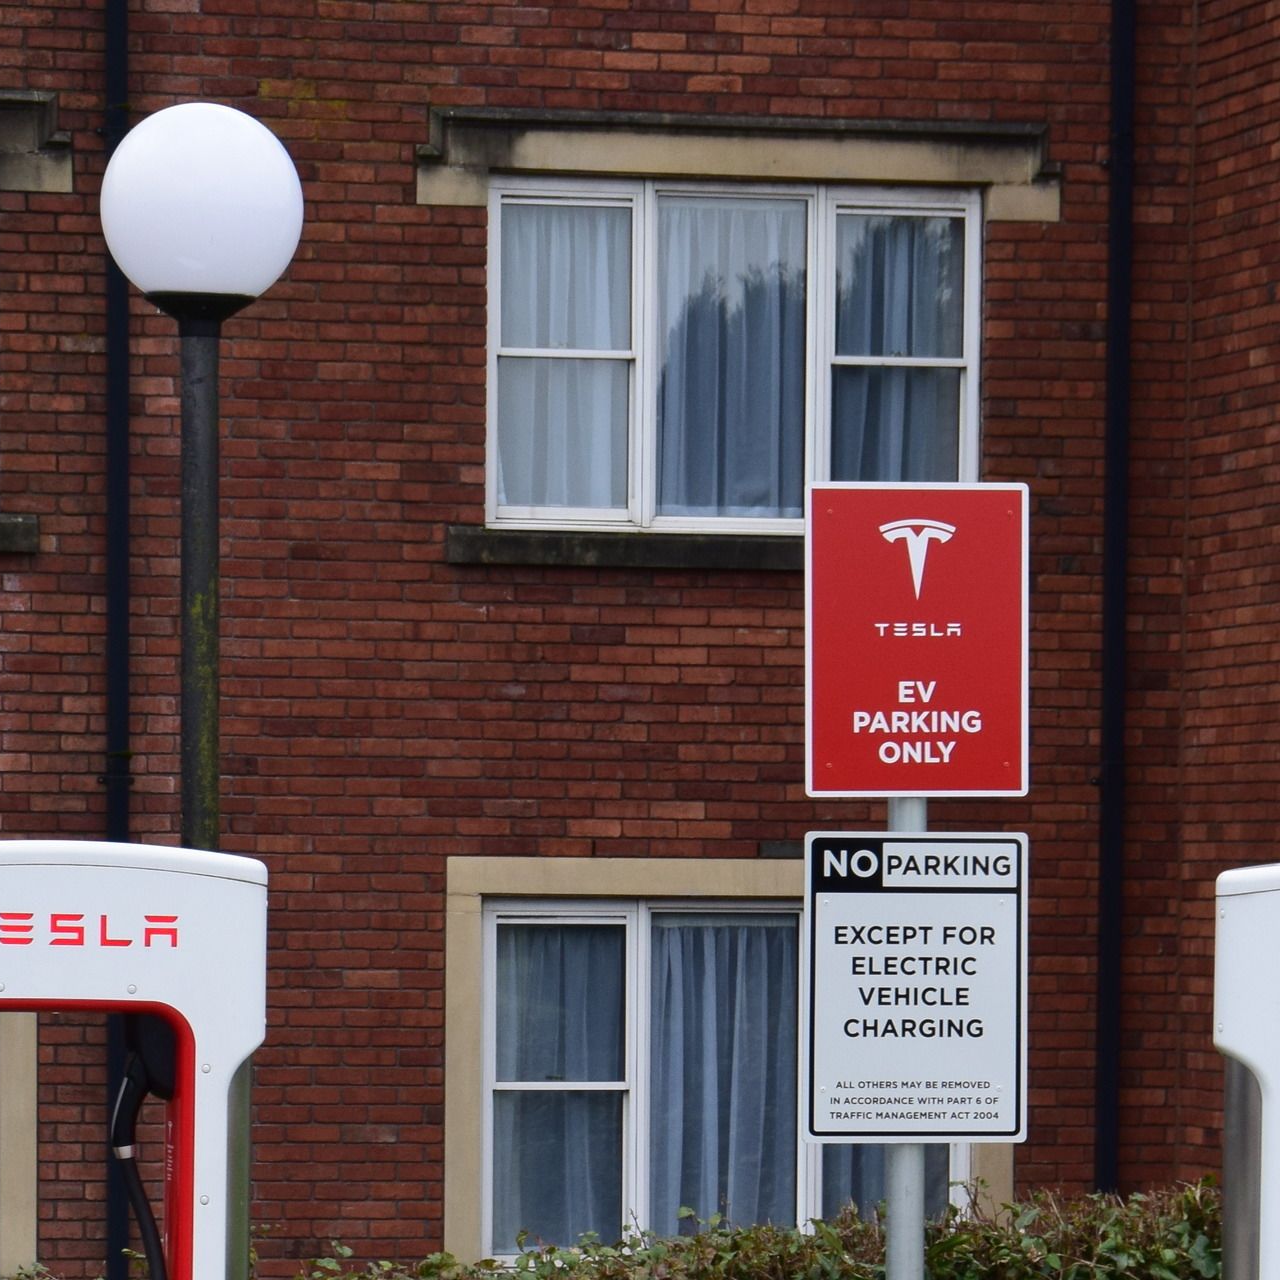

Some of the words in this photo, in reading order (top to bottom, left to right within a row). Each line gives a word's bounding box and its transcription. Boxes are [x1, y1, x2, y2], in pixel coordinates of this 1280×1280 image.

[874, 623, 962, 637] TESLA
[898, 681, 937, 703] EV
[852, 711, 983, 734] PARKING
[878, 741, 957, 764] ONLY
[823, 849, 879, 878] NO
[886, 855, 1012, 876] PARKING
[834, 926, 934, 945] EXCEPT
[942, 926, 996, 946] FOR
[851, 957, 977, 976] ELECTRIC
[858, 987, 970, 1006] VEHICLE
[843, 1018, 984, 1038] CHARGING
[835, 1080, 855, 1090] ALL
[857, 1080, 899, 1090] OTHERS
[900, 1080, 923, 1090] MAY
[925, 1080, 939, 1090] BE
[940, 1080, 991, 1090] REMOVED
[829, 1096, 841, 1106] IN
[843, 1096, 914, 1106] ACCORDANCE
[916, 1096, 944, 1106] WITH
[946, 1096, 973, 1106] PART
[974, 1096, 982, 1106] 6
[984, 1096, 999, 1106] OF
[829, 1111, 873, 1121] TRAFFIC
[874, 1111, 947, 1121] MANAGEMENT
[949, 1111, 970, 1121] ACT
[972, 1111, 1000, 1121] 2004
